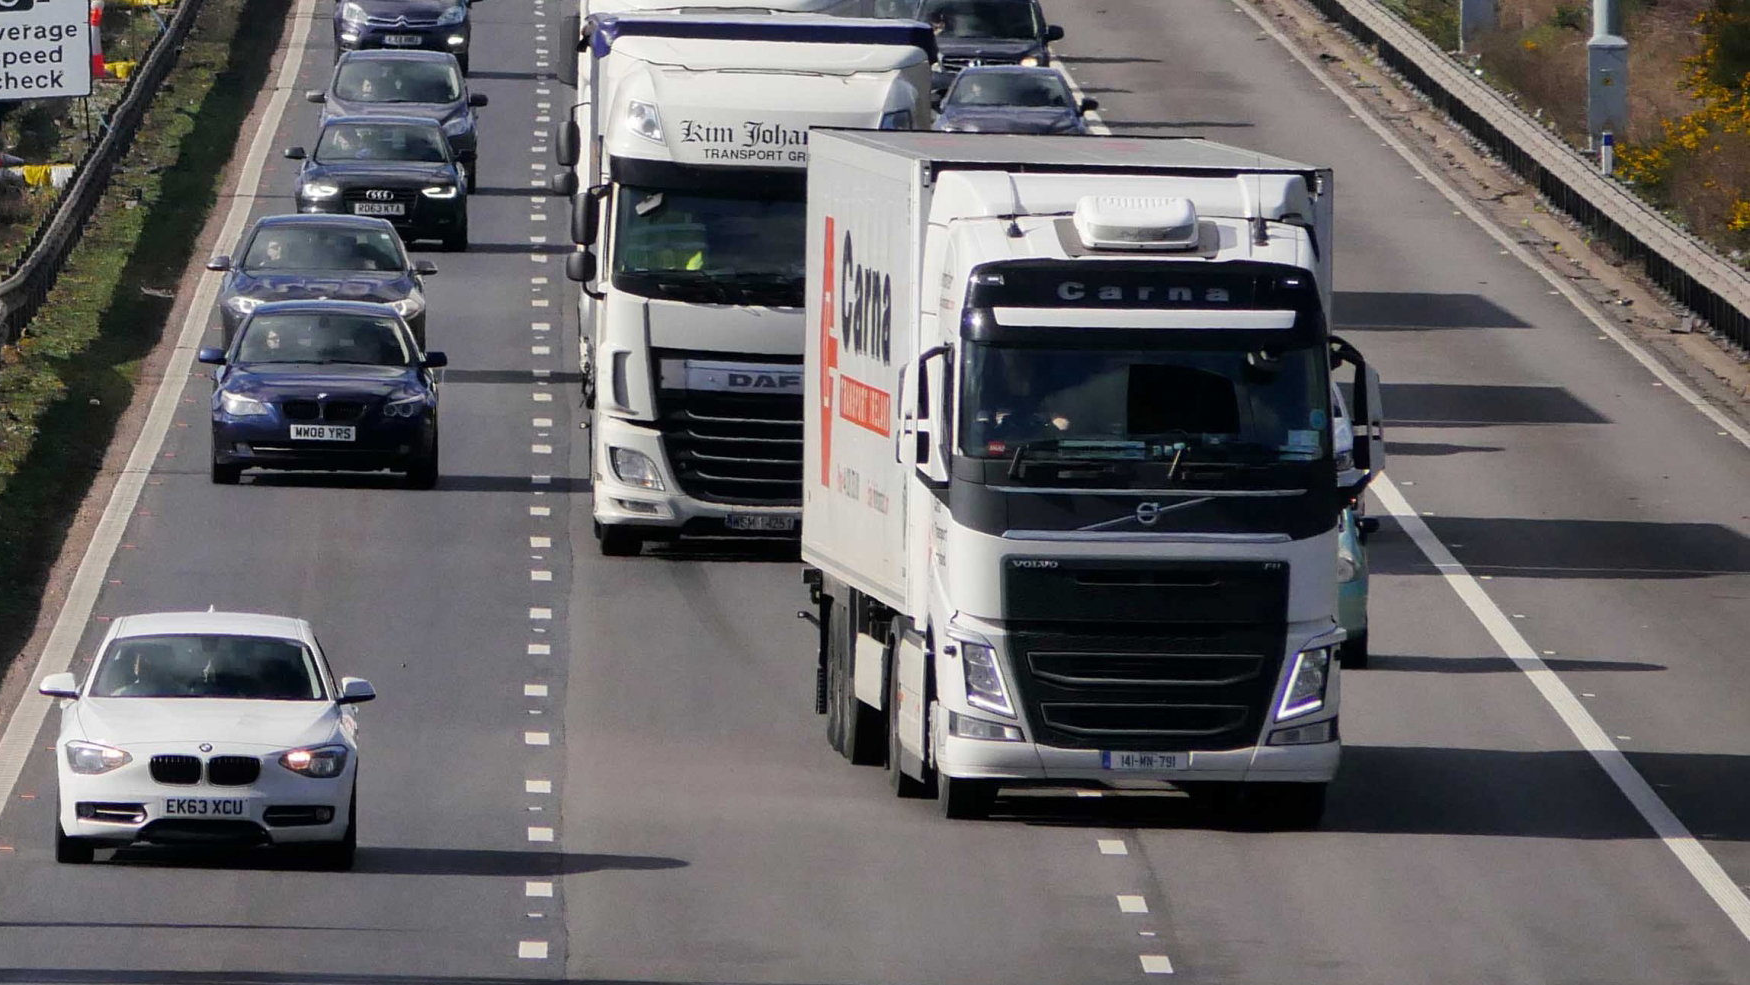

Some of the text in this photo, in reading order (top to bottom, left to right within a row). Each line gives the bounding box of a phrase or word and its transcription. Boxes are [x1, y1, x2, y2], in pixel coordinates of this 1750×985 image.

[680, 120, 734, 144] Kim
[704, 149, 783, 161] TRANSPORT
[842, 229, 891, 367] Carna
[1057, 282, 1228, 301] Carna
[1013, 560, 1059, 570] VOLVO
[166, 799, 243, 815] EK63 XCU
